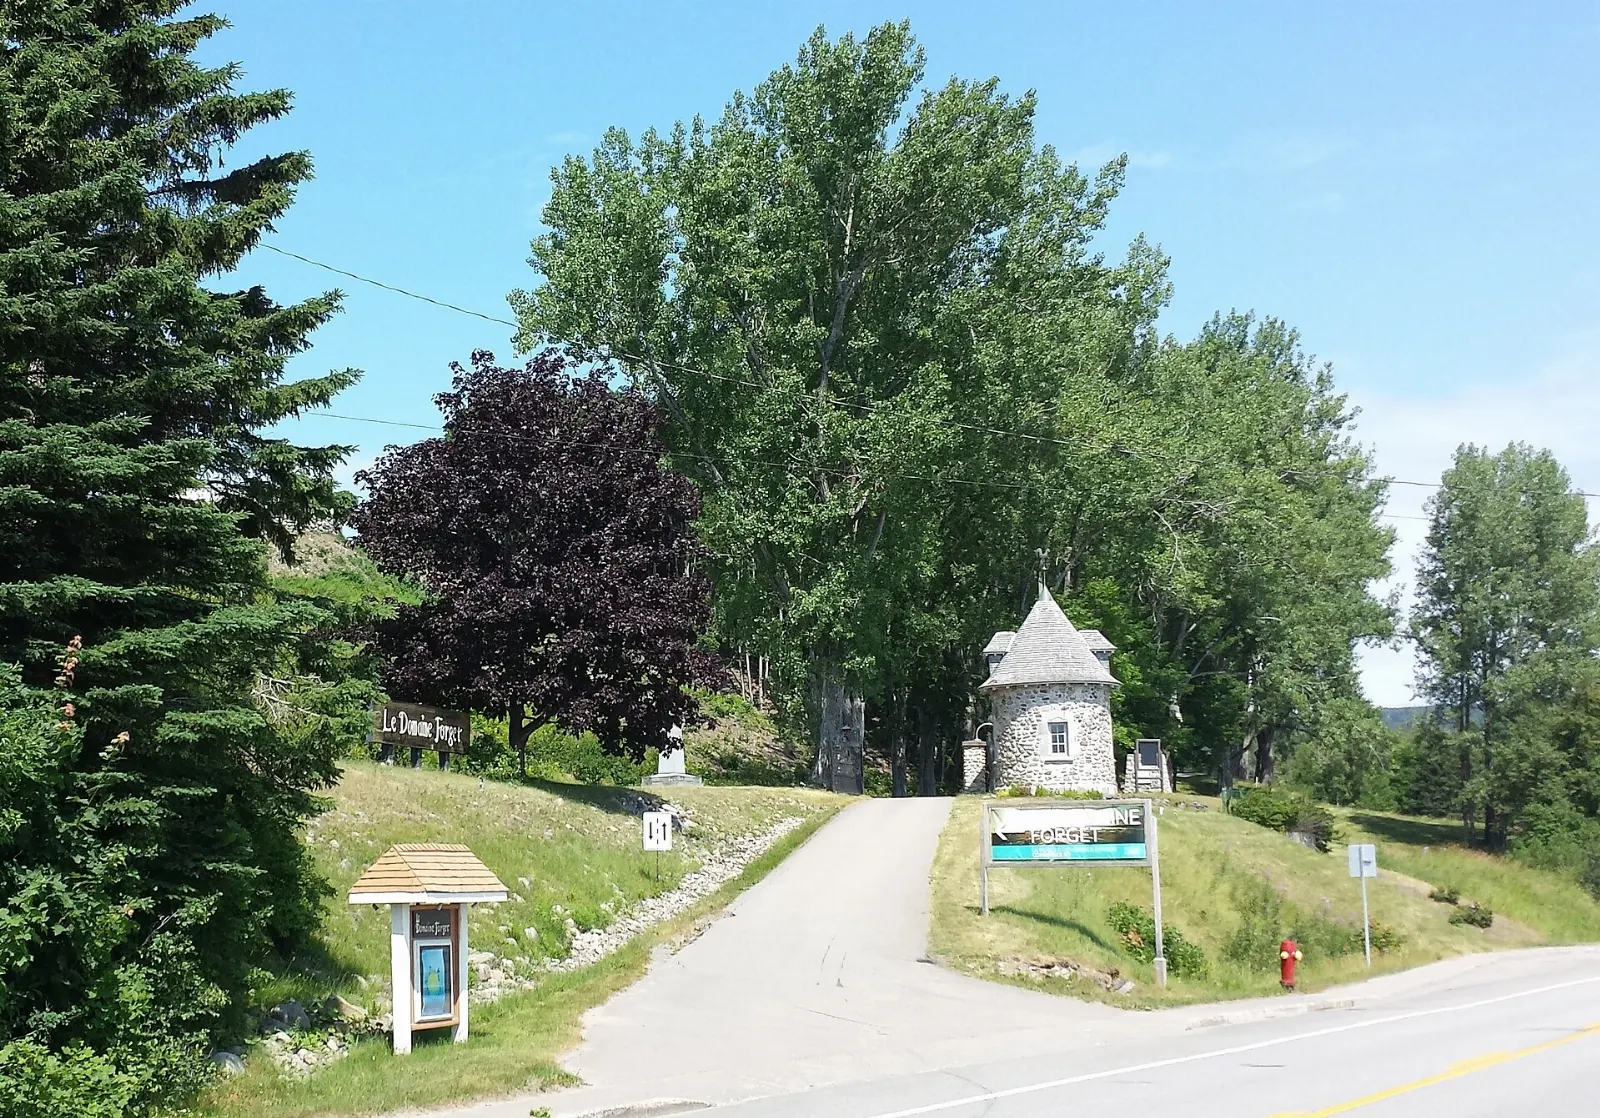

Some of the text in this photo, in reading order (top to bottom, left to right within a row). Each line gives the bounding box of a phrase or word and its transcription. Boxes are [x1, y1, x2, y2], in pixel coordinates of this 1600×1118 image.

[382, 708, 463, 747] Le Domaine Forget
[1030, 827, 1100, 844] FORGET
